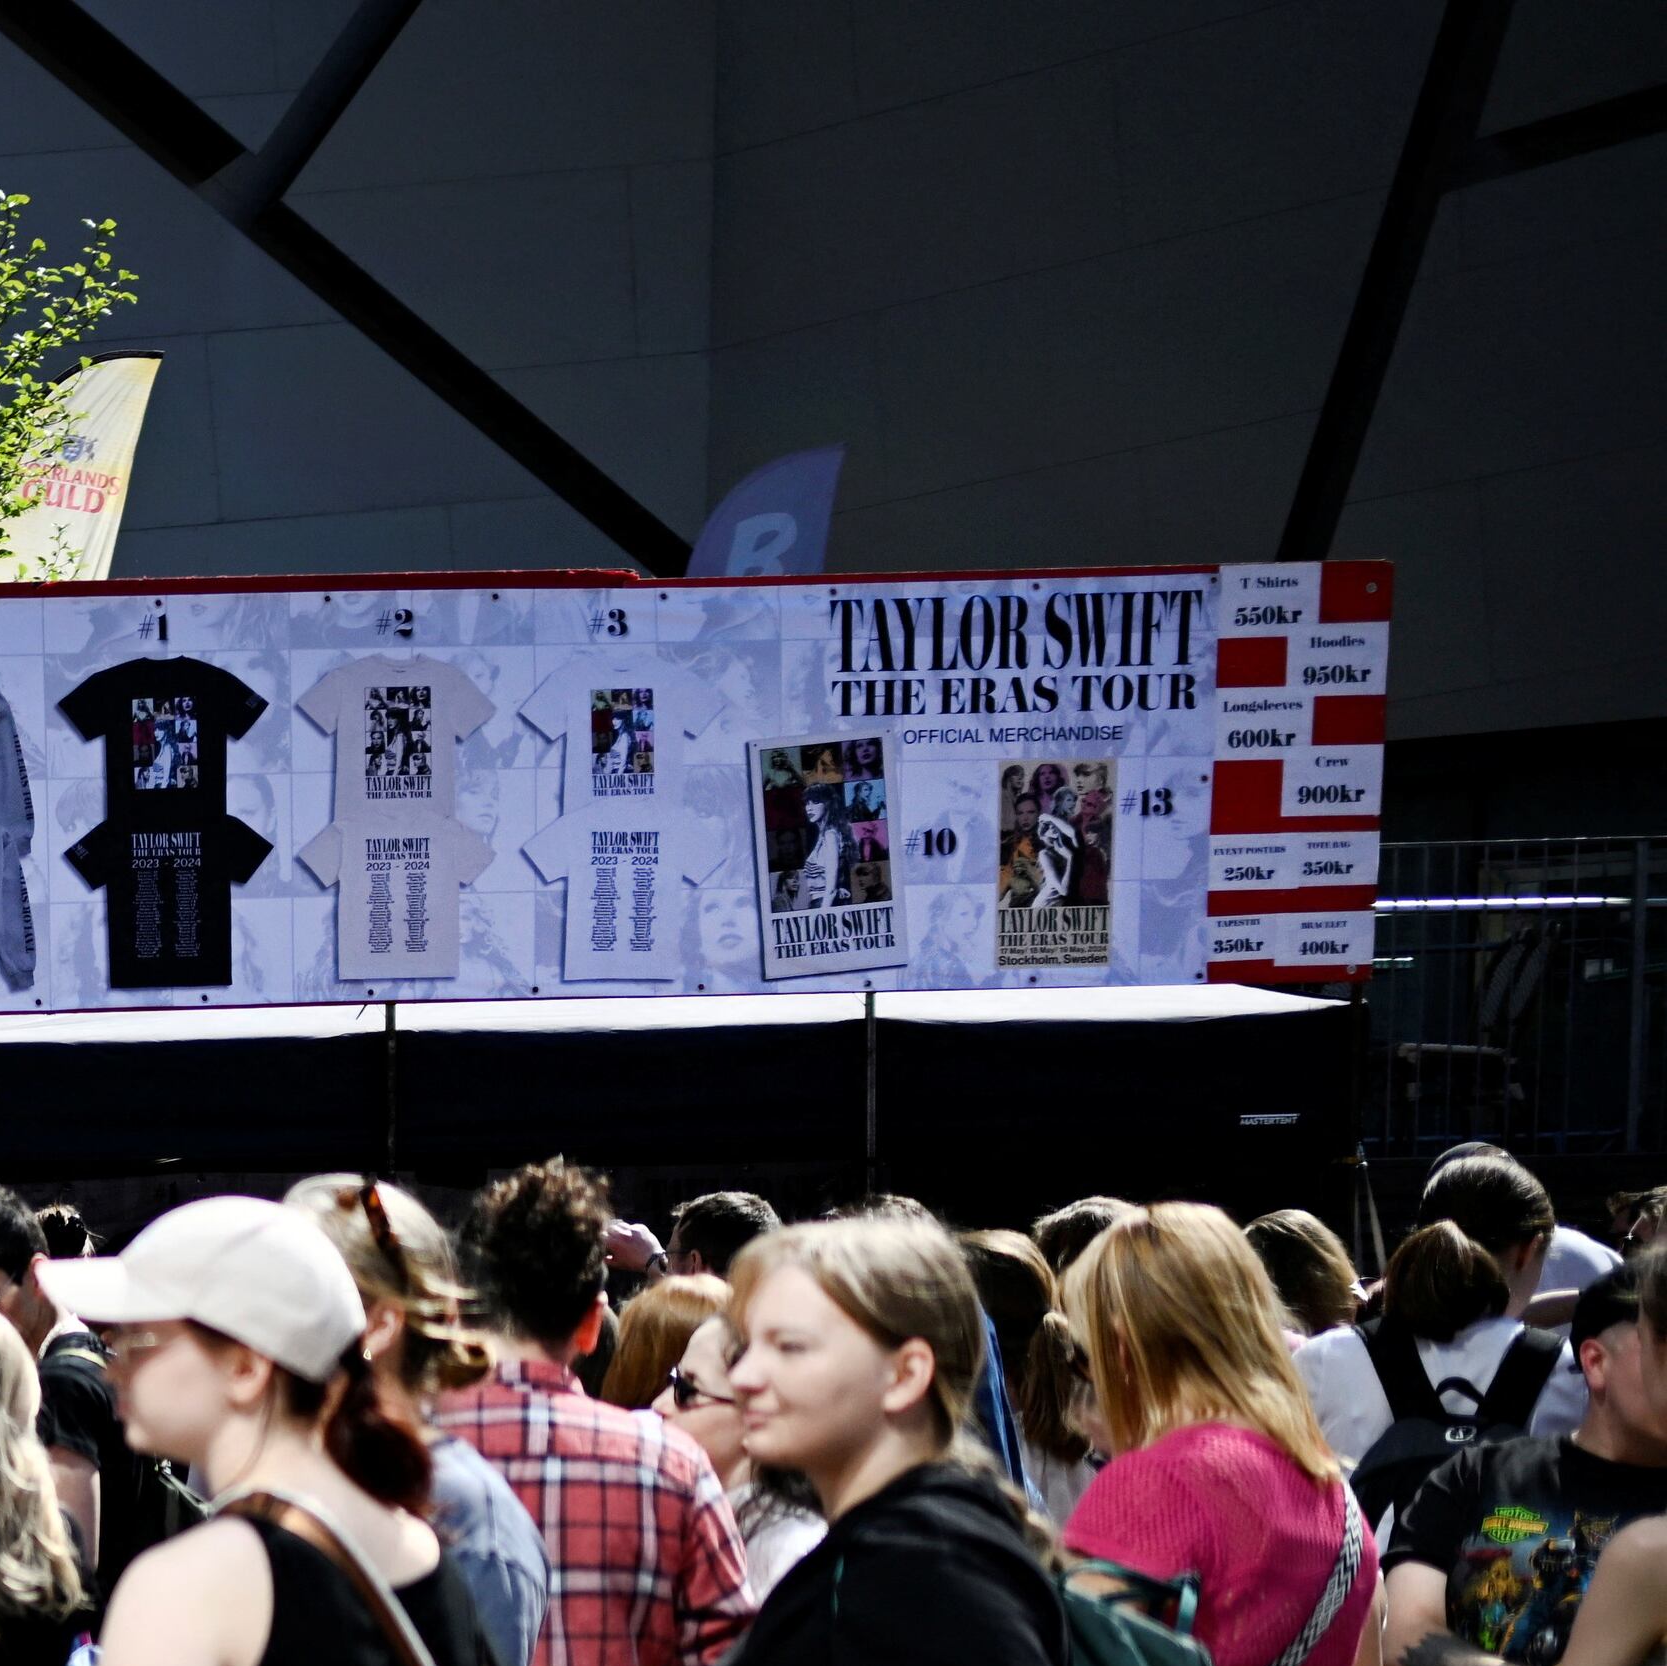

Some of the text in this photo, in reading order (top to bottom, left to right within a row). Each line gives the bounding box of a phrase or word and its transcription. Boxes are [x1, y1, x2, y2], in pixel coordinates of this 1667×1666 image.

[1240, 576, 1299, 589] T Shirts
[375, 608, 414, 638] #2
[590, 608, 629, 638] #3
[1234, 605, 1303, 627] 550kr
[137, 613, 170, 641] #1
[830, 589, 1203, 673] TAYLOR SWIFT
[1310, 635, 1365, 649] Hoodies
[1302, 664, 1371, 686] 950kr
[831, 673, 1197, 717] THE ERAS TOUR
[1223, 699, 1303, 714] Longsleeves
[903, 725, 1123, 745] OFFICIAL MERCHANDISE
[1227, 728, 1296, 749] 600kr
[1315, 756, 1350, 768] Crew
[366, 775, 432, 791] TAYLOR SWIFT
[592, 774, 654, 789] TAYLOR SWIFT
[366, 790, 432, 800] THE ERAS TOUR
[593, 789, 609, 797] THE
[1297, 784, 1365, 804] 900kr
[1120, 787, 1173, 817] #13
[131, 832, 201, 849] TAYLOR SWIFT
[365, 838, 429, 853] TAYLOR SWIFT
[591, 831, 660, 847] TAYLOR SWIFT
[904, 827, 957, 857] #10
[1307, 841, 1351, 850] TOTE BAG
[132, 847, 201, 857] THE ERAS TOUR
[385, 852, 406, 860] ERAS
[408, 851, 429, 859] TOUR
[592, 846, 659, 855] THE ERAS TOUR
[1213, 845, 1286, 856] EVENT POSTERS
[132, 858, 201, 869] 2023 2024
[366, 861, 430, 871] 2023 2024
[591, 856, 659, 866] 2023 2024
[1302, 861, 1354, 876] 350kr
[1224, 866, 1275, 881] 250kr
[772, 906, 894, 945] TAYLOR SWIFT
[998, 907, 1110, 933] TAYLOR SWIFT
[1216, 918, 1260, 928] TAPESTRY
[1300, 920, 1348, 930] BRACELET
[775, 933, 895, 959] THE ERAS TOUR
[998, 932, 1109, 946] THE ERAS TOUR
[1213, 938, 1264, 954] 350kr
[1298, 941, 1349, 956] 400kr
[998, 953, 1108, 966] Stockholm, Sweden
